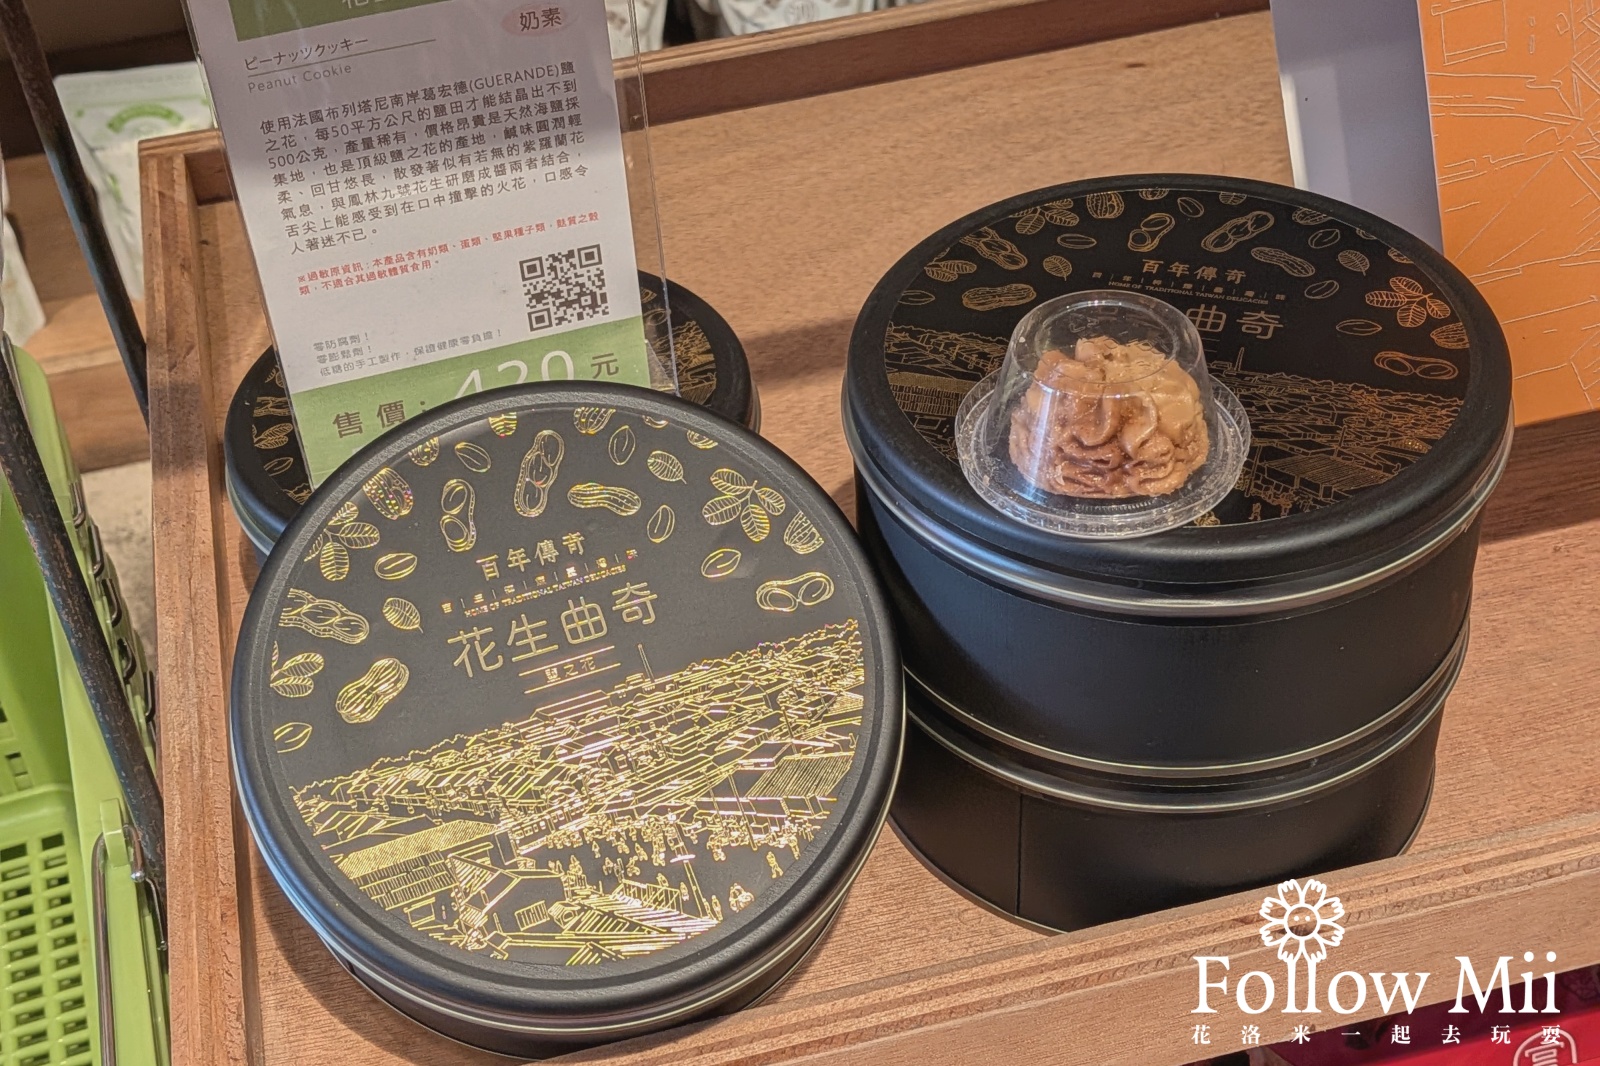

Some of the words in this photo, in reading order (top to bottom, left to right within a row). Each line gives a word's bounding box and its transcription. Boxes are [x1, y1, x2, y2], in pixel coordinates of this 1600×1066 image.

[518, 6, 563, 32] 奶素
[244, 37, 369, 71] ピーナッツクッキー
[247, 75, 297, 93] Peanut
[302, 63, 352, 82] Cookie
[290, 227, 378, 256] 人著迷不已。
[1141, 258, 1247, 285] 百年傳奇
[1108, 280, 1131, 289] HOME
[1144, 284, 1194, 297] TRADITIONAL
[1195, 291, 1226, 301] TAIWAN
[590, 352, 620, 380] 元
[475, 531, 586, 581] 百年傳奇
[464, 603, 489, 618] HOME
[489, 601, 500, 611] OF
[501, 586, 553, 607] TRADITIONAL
[552, 576, 584, 593] TAIWAN
[447, 582, 658, 678] 花生曲奇
